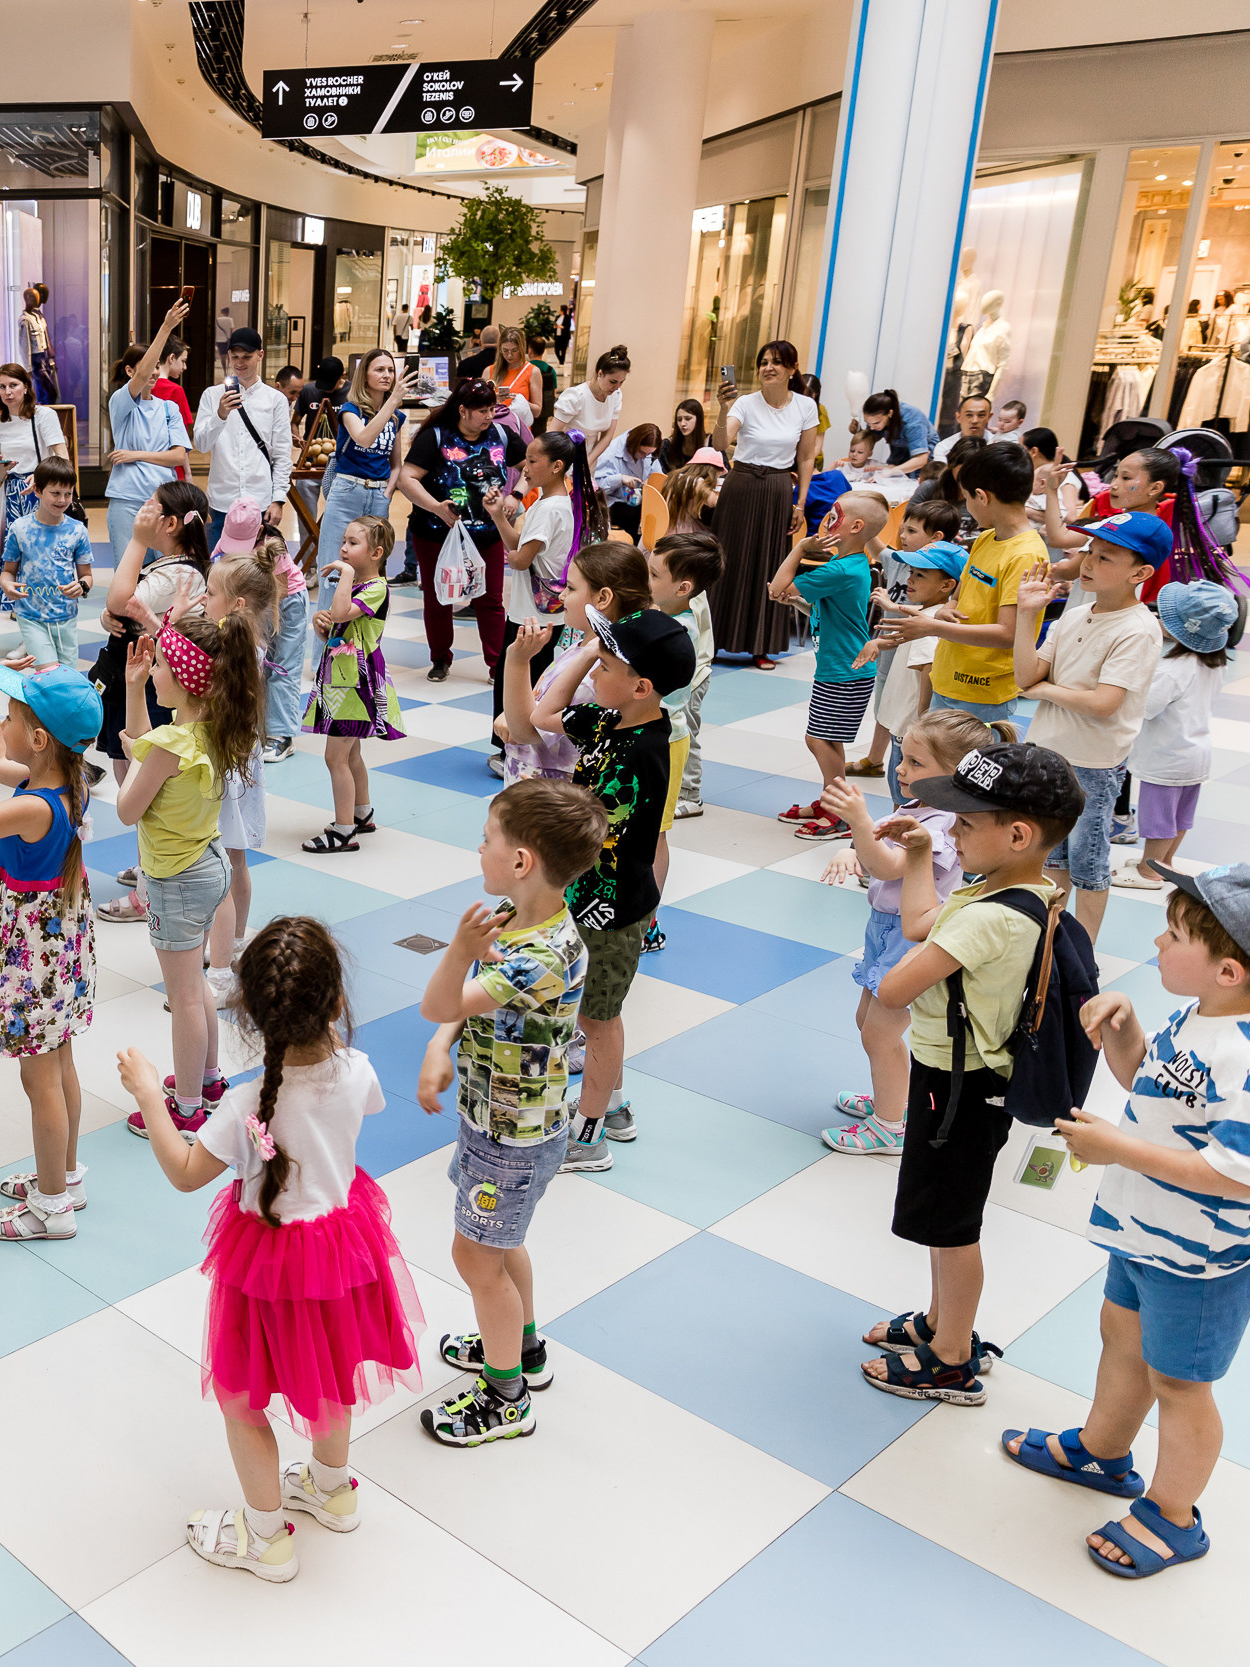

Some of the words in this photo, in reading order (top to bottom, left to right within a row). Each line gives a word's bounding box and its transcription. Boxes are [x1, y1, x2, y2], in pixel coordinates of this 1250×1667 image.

[305, 77, 327, 87] YVES
[328, 75, 364, 86] ROCHER
[423, 81, 464, 91] SOKOLOV
[304, 86, 361, 97] ХАМОВНИКИ
[423, 91, 454, 101] TEZENIS
[305, 97, 338, 107] ТУАЛЕТ
[954, 671, 991, 687] DISTANCE
[1168, 1050, 1206, 1089] NOISY
[1154, 1073, 1198, 1109] CLUB
[461, 1206, 504, 1229] SPORTS
